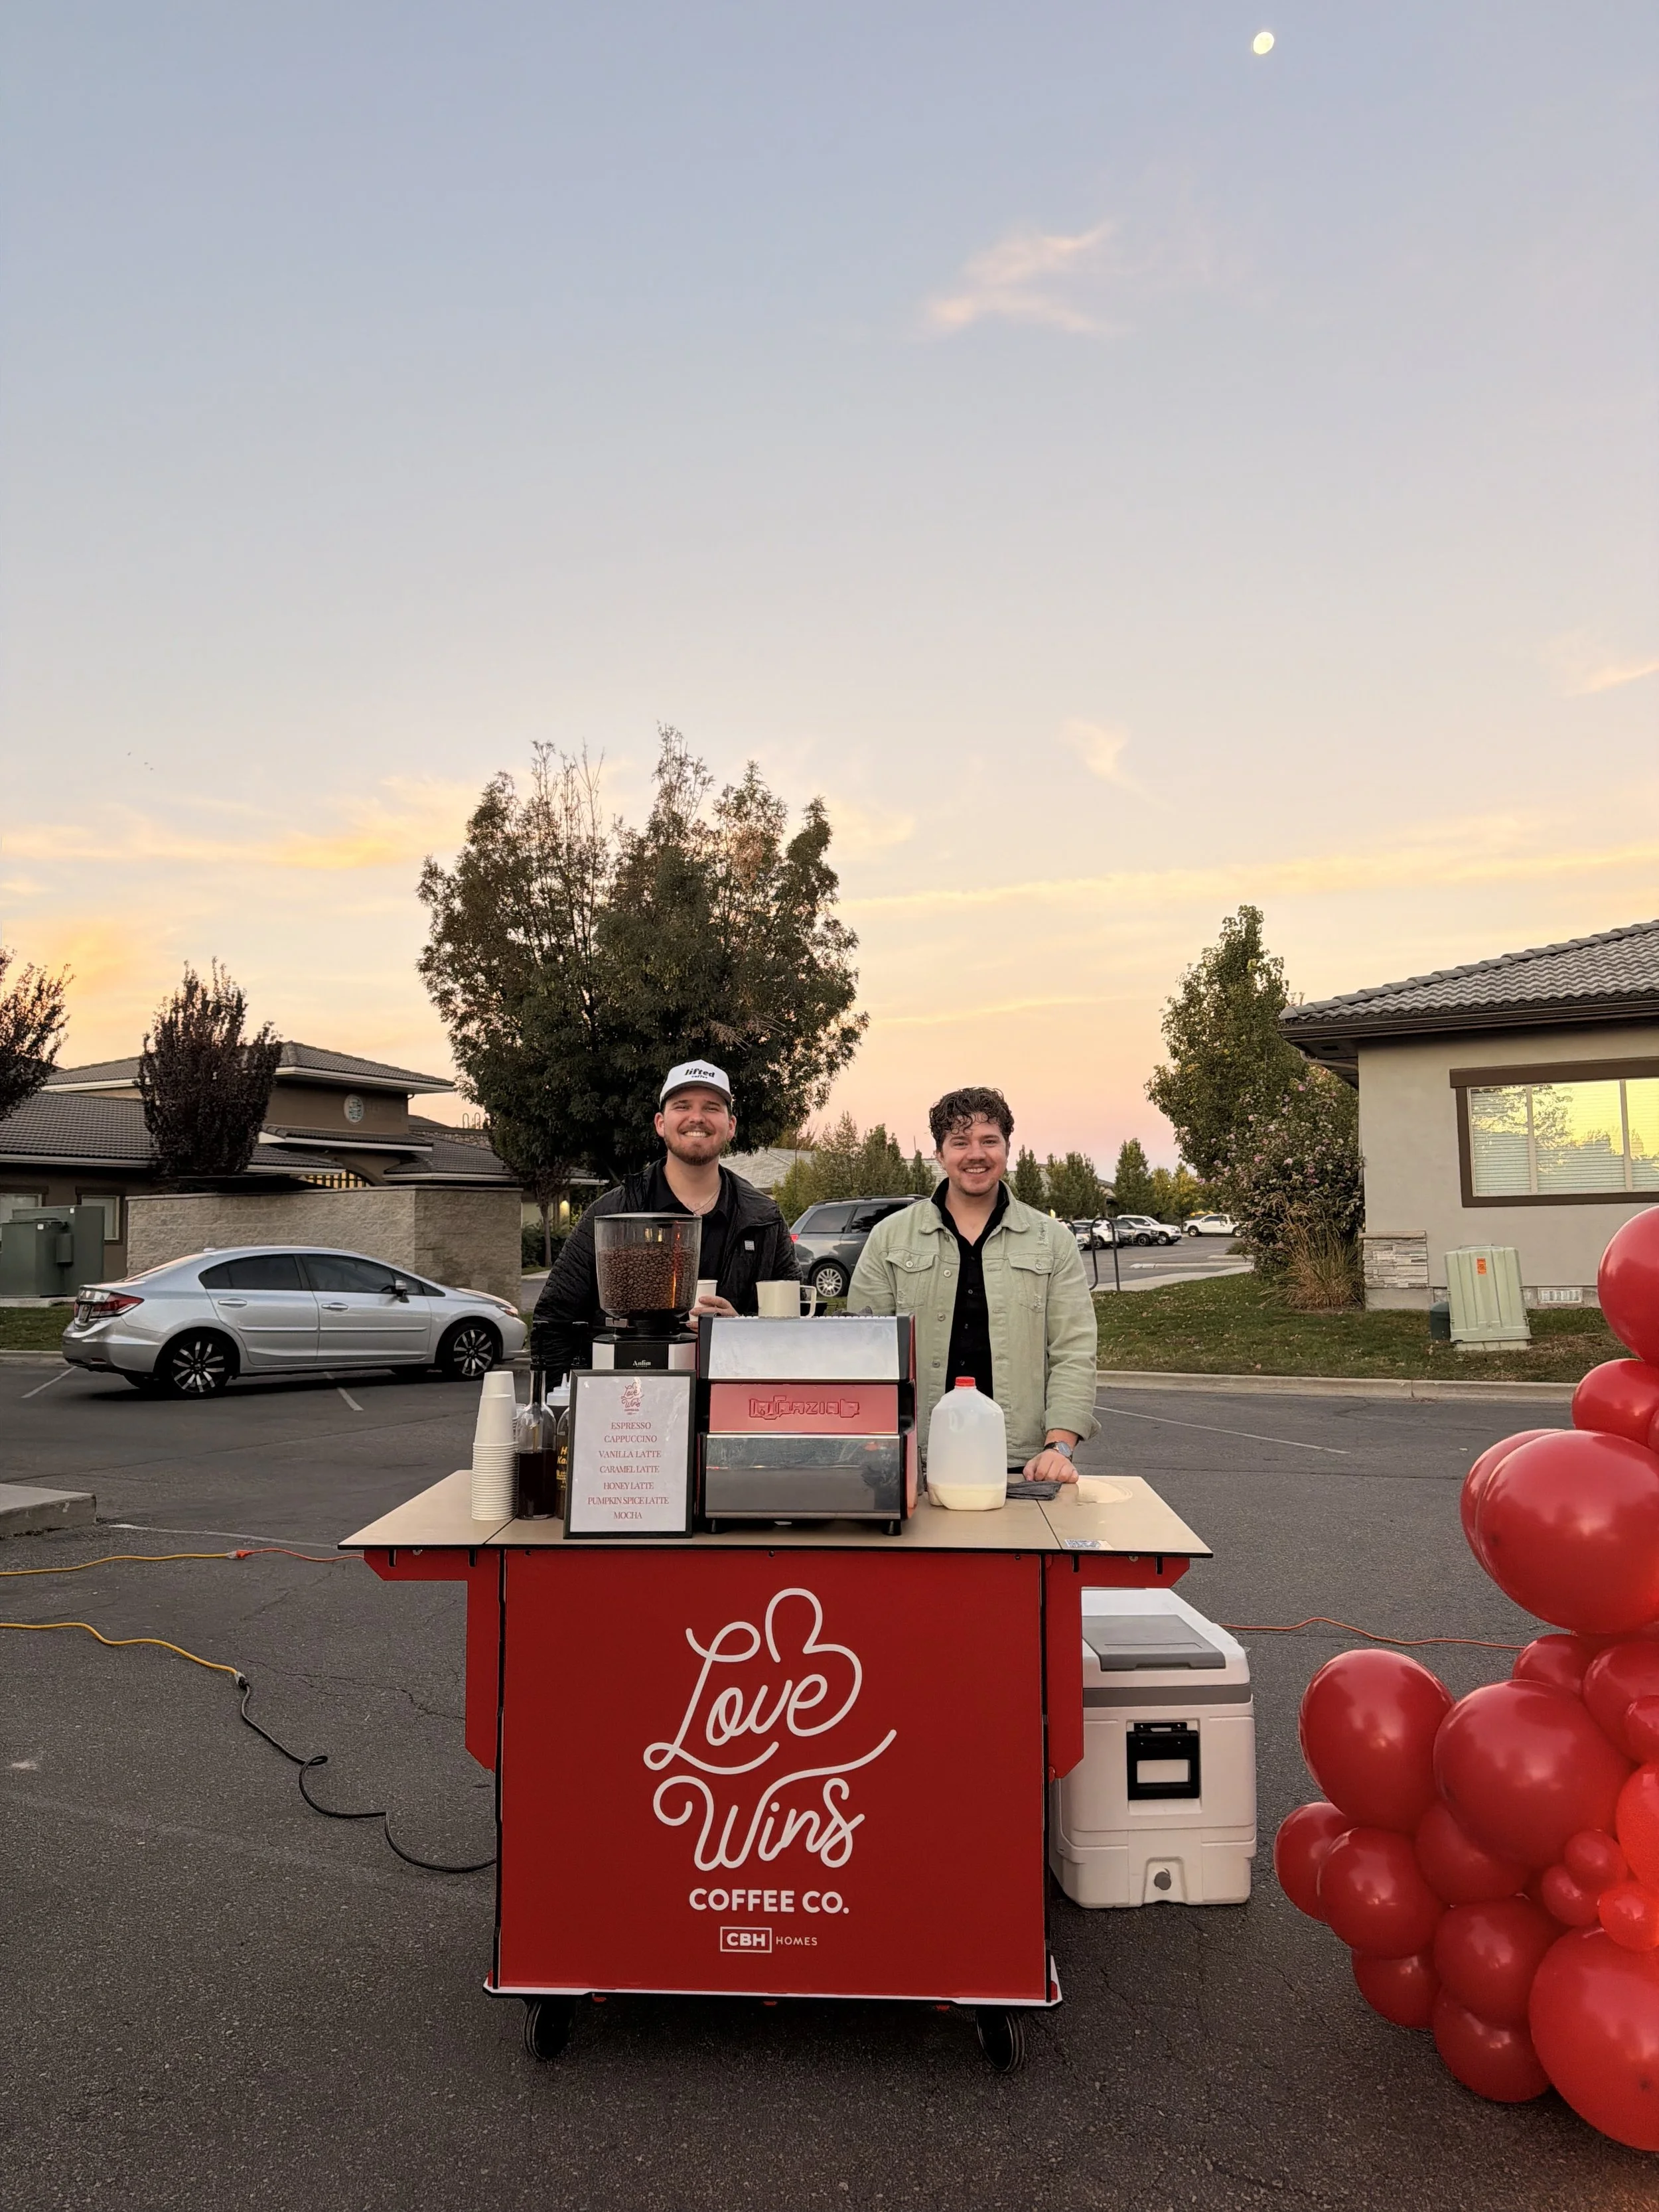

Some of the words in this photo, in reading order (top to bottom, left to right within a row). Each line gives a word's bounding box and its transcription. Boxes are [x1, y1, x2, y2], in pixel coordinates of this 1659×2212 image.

[685, 1069, 715, 1078] lifted
[643, 1587, 862, 1775] Love
[653, 1730, 897, 1871] Wins
[689, 1888, 794, 1913] COFFEE
[802, 1890, 849, 1914] CO.
[727, 1933, 765, 1947] CBH
[776, 1936, 818, 1946] HOMES
